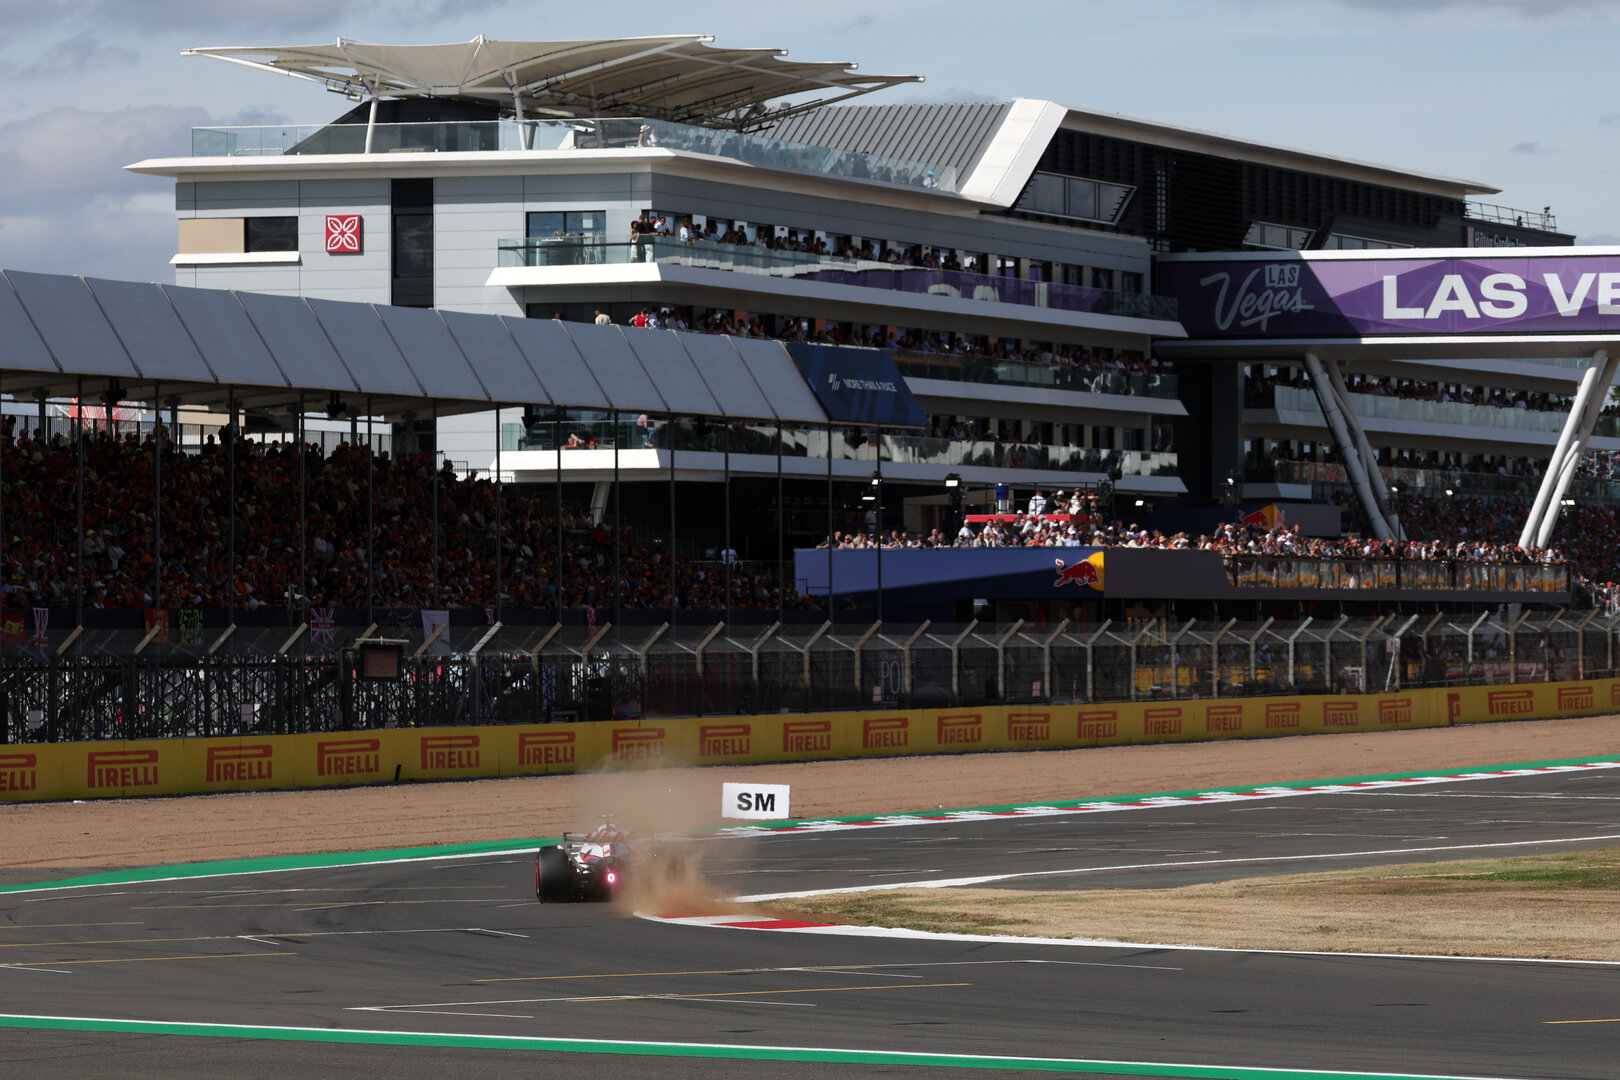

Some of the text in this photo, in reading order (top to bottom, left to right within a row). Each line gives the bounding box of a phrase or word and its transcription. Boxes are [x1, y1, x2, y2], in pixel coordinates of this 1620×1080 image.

[1268, 266, 1298, 285] LAS
[1200, 268, 1314, 332] Vegas
[1382, 273, 1528, 319] LAS
[1323, 701, 1358, 726] PIRELLI
[1379, 698, 1411, 724] PIRELLI
[1488, 690, 1533, 715] PIRELLI
[1558, 687, 1593, 710] PIRELLI
[937, 714, 982, 744] PIRELLI
[1008, 713, 1050, 741] PIRELLI
[1077, 710, 1118, 739] PIRELLI
[1144, 708, 1183, 735] PIRELLI
[1207, 705, 1243, 732] PIRELLI
[1266, 702, 1300, 729] PIRELLI
[519, 731, 576, 765] PIRELLI
[612, 728, 665, 760] PIRELLI
[700, 725, 751, 756] PIRELLI
[783, 721, 832, 753] PIRELLI
[863, 718, 909, 748] PIRELLI
[207, 745, 272, 782] PIRELLI
[318, 739, 380, 776] PIRELLI
[421, 735, 480, 769] PIRELLI
[0, 754, 36, 791] ELLI
[88, 750, 158, 788] PIRELLI
[737, 792, 775, 812] SM
